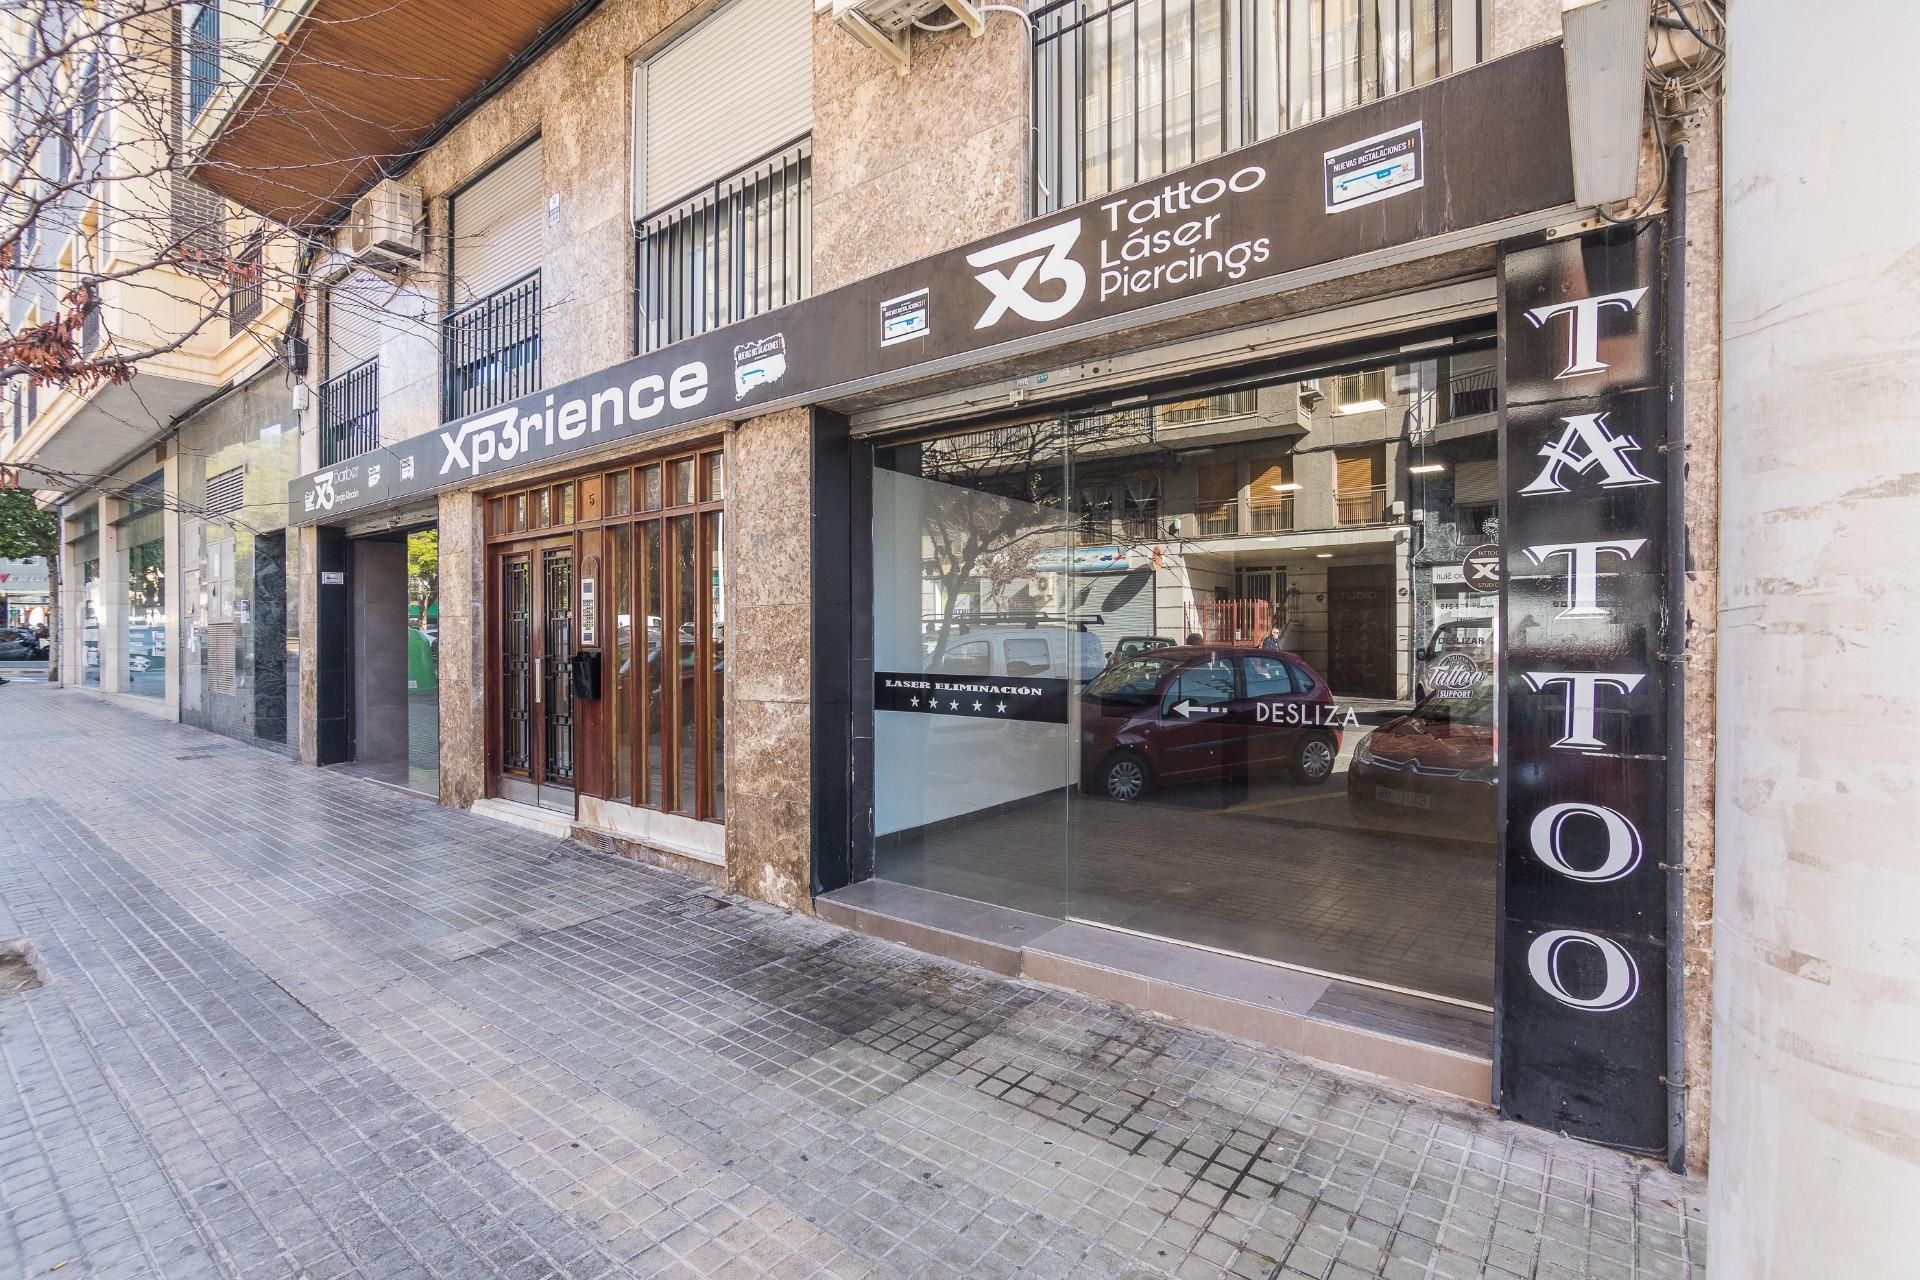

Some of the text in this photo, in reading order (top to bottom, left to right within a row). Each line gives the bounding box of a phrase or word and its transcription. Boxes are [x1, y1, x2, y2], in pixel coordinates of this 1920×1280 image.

[1333, 157, 1358, 172] NUEVAS
[1358, 142, 1407, 164] INSTALACIONES
[1101, 166, 1267, 232] Tattoo
[1101, 213, 1222, 269] Láser
[1101, 237, 1271, 302] Piercings
[438, 360, 708, 476] Xp3rience
[588, 493, 595, 507] 5
[1438, 637, 1485, 645] DESLIZAR
[1517, 286, 1662, 1012] TATTOO
[885, 679, 1043, 696] LASER ELIMINACIÓN
[1428, 664, 1486, 686] Tattoo
[1256, 702, 1360, 727] DESLIZA
